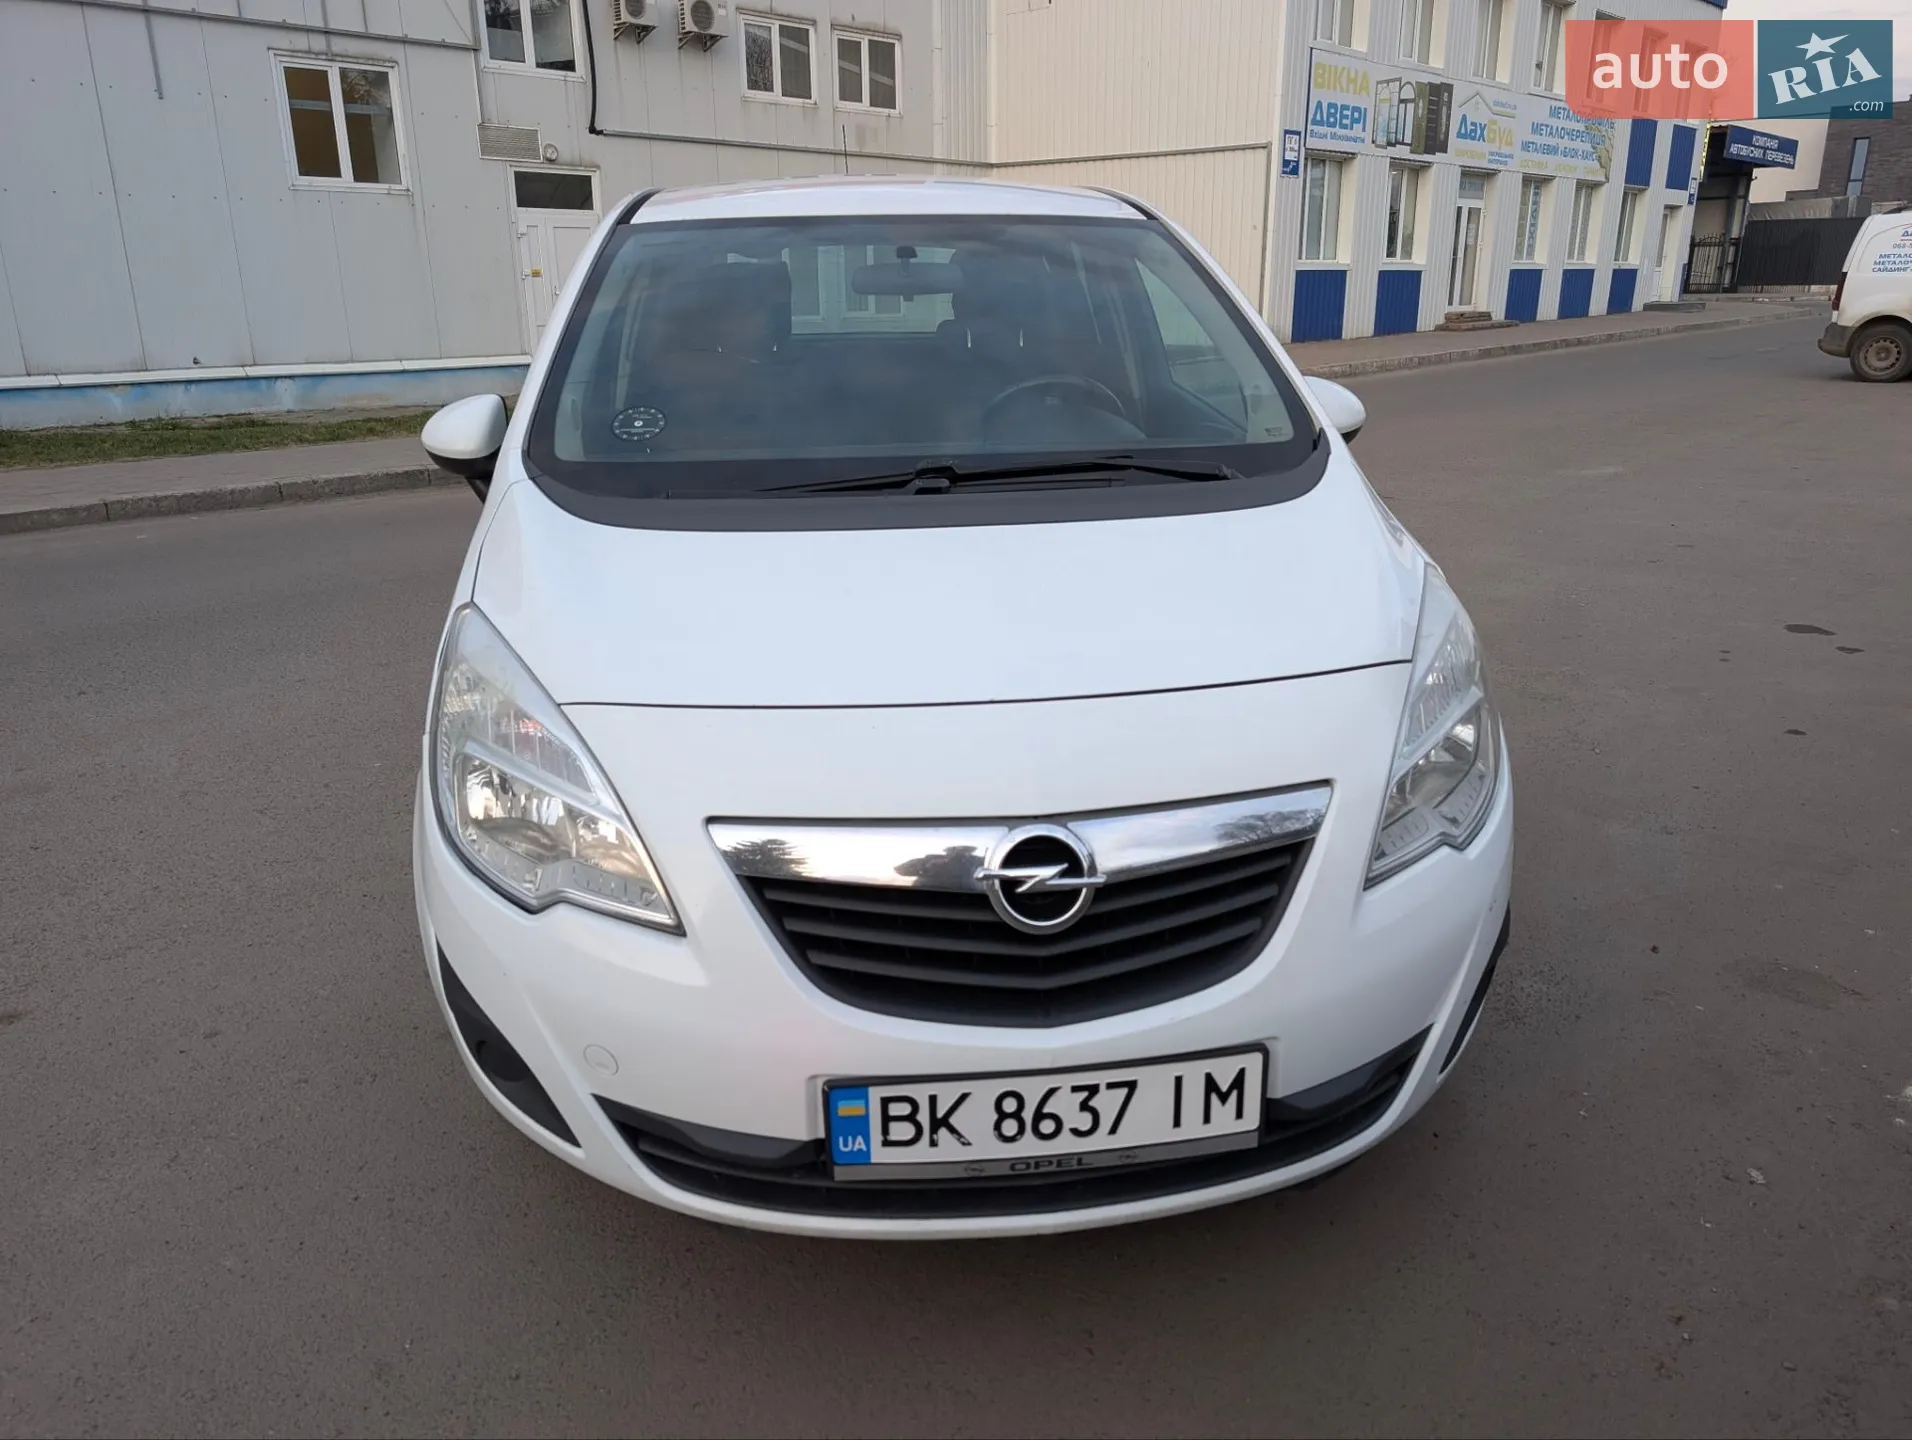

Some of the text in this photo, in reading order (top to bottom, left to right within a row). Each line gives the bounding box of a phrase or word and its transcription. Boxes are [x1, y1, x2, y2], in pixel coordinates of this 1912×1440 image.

[1314, 62, 1371, 98] ВІКНА
[1310, 99, 1368, 133] ДВЕРІ
[1521, 139, 1560, 157] МЕТАЛЕВИЙ
[880, 1066, 1247, 1148] BK 8637 IM
[838, 1134, 867, 1152] UA
[1009, 1157, 1094, 1173] OPEL
